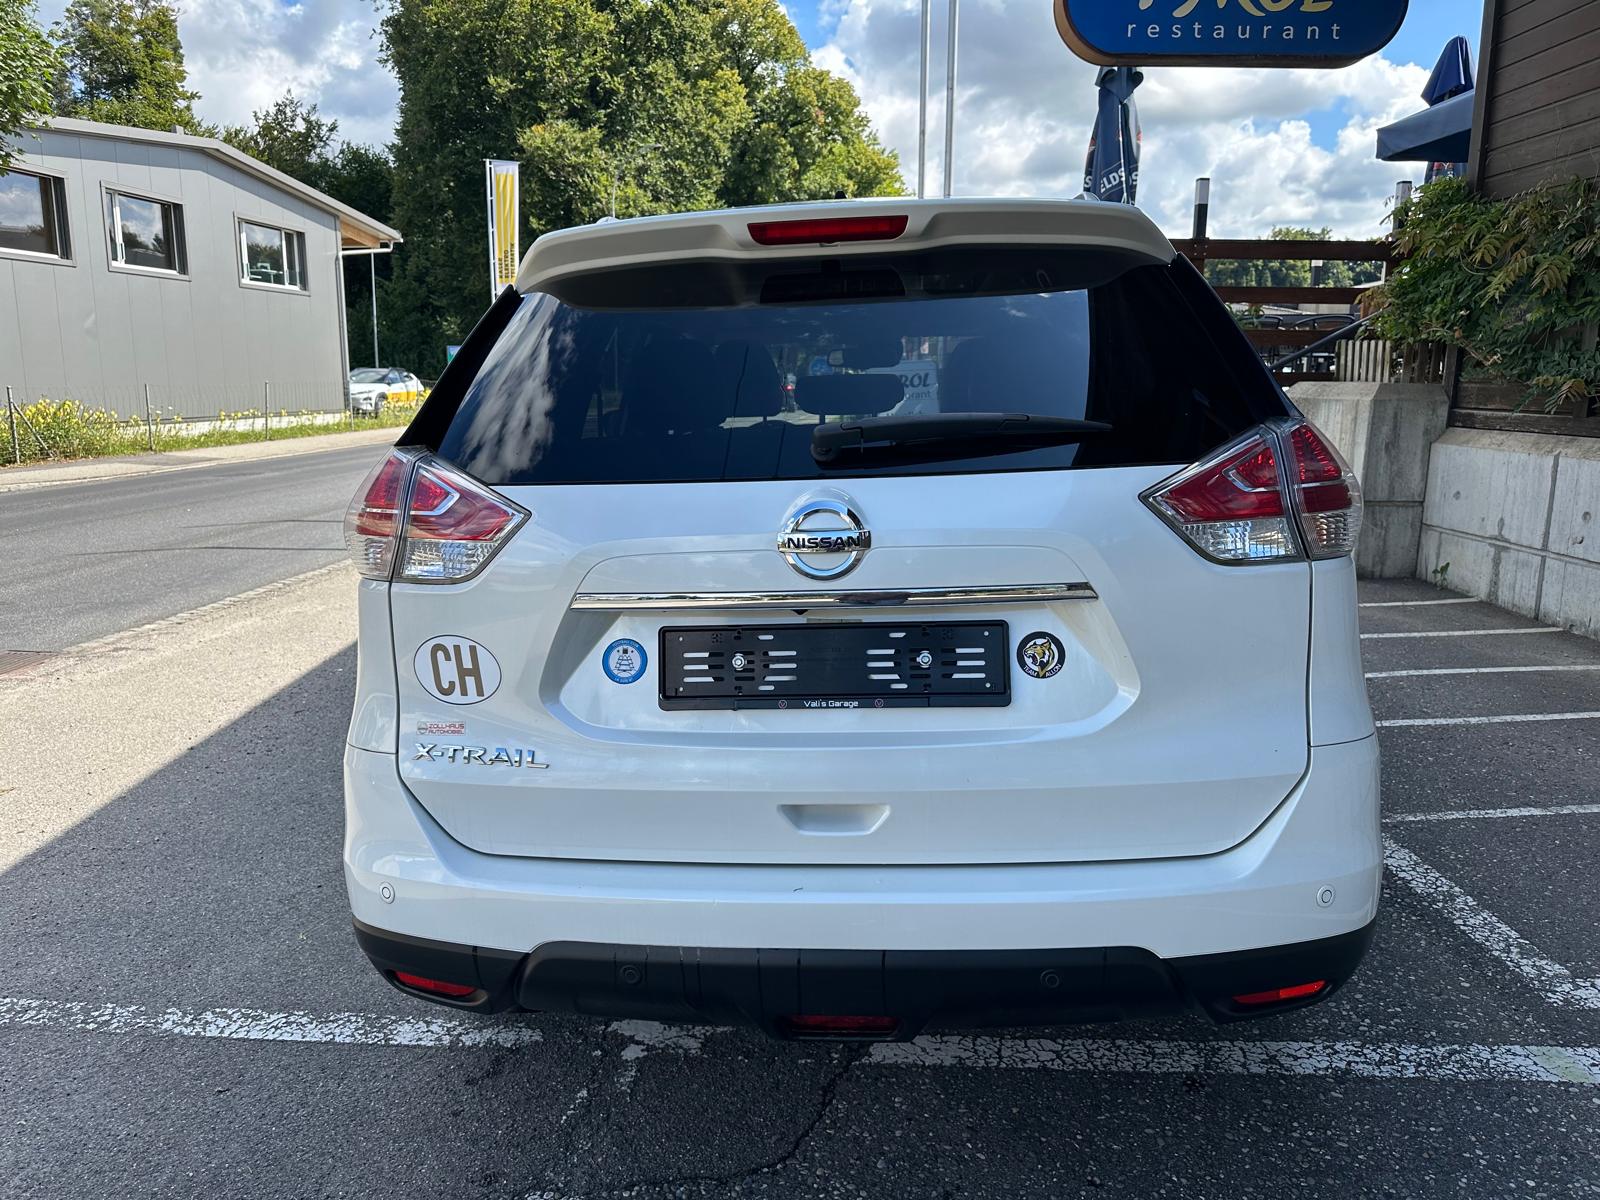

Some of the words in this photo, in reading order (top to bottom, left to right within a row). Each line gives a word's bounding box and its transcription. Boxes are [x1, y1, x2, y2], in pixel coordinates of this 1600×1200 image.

[1127, 21, 1340, 40] restaurant
[900, 372, 930, 388] ROL
[786, 535, 861, 549] NISSAN
[430, 643, 485, 697] CH
[1023, 665, 1038, 677] TEAM
[803, 699, 827, 708] Vali's
[828, 700, 859, 709] Garage
[412, 743, 550, 769] X-TRAIL
